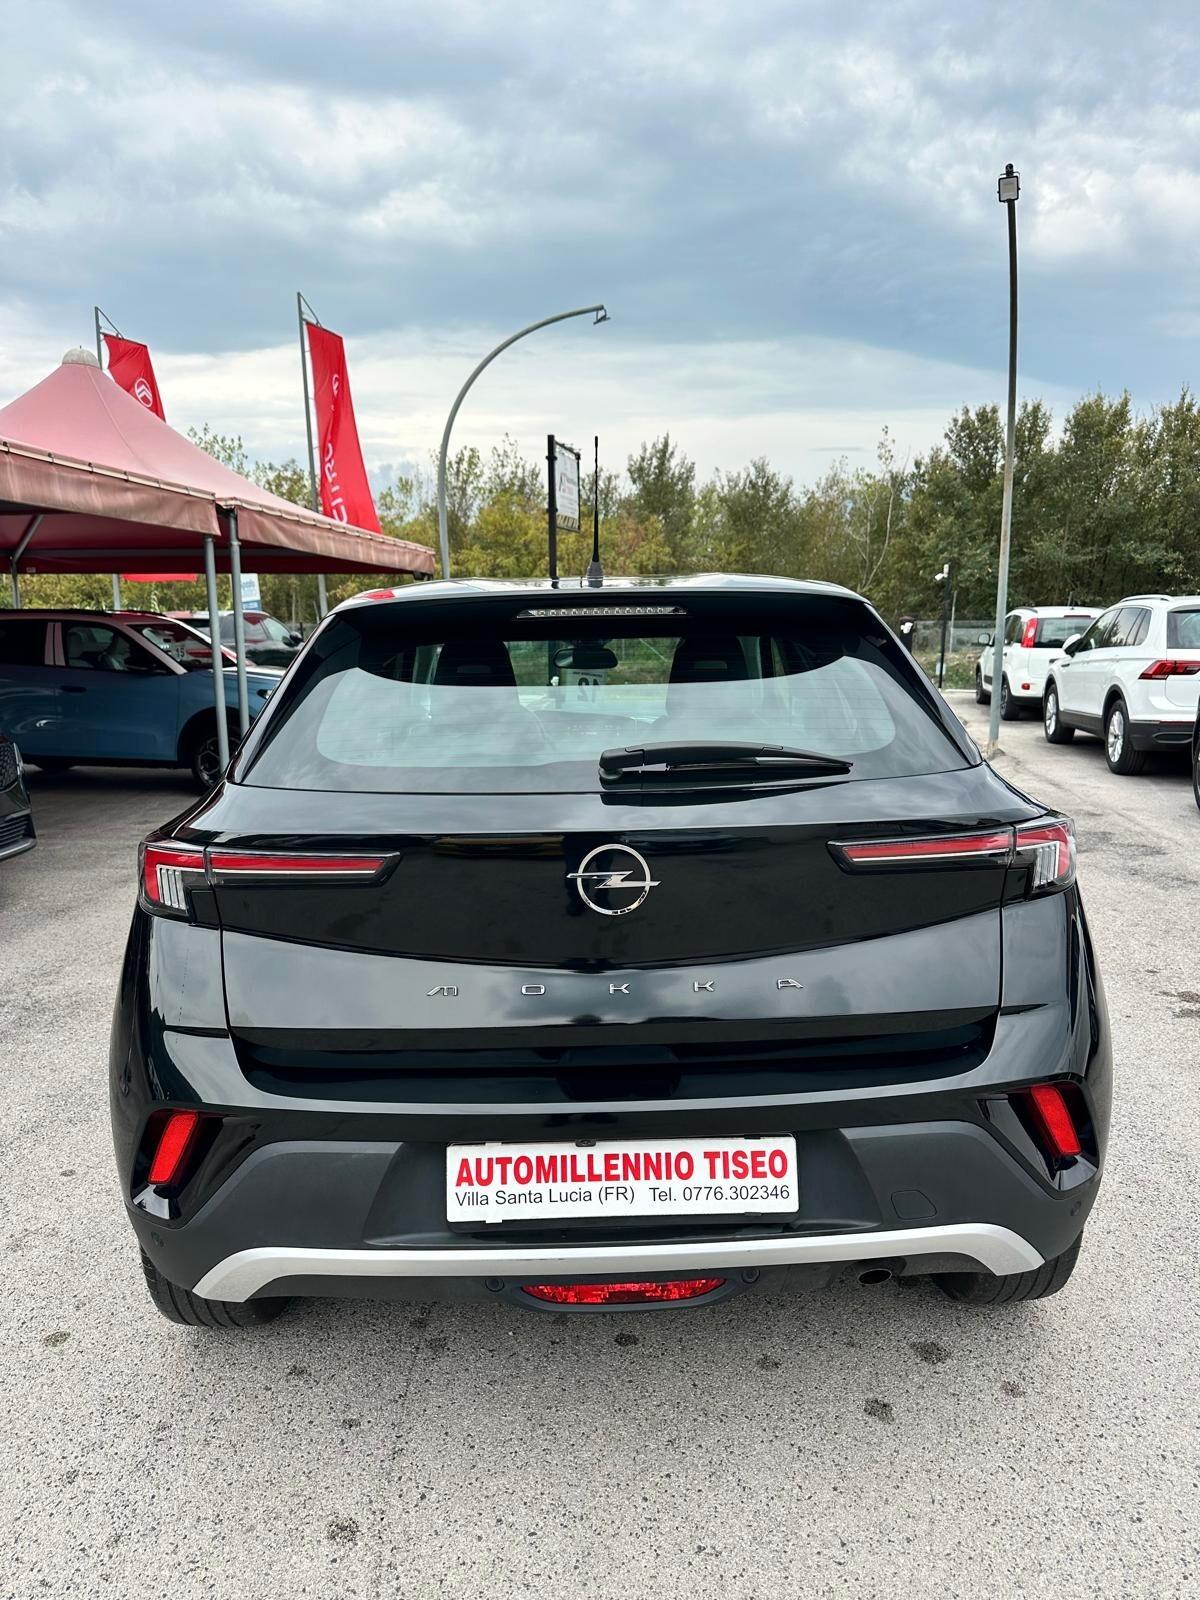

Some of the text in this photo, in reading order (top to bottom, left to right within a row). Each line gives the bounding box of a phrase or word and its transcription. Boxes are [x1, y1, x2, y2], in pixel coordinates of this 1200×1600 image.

[427, 977, 804, 996] MOKKA
[455, 1149, 788, 1187] AUTOMILLENNIO TISEO
[455, 1184, 790, 1207] Villa Santa Lucia (FR) Tel. 0776.302346
